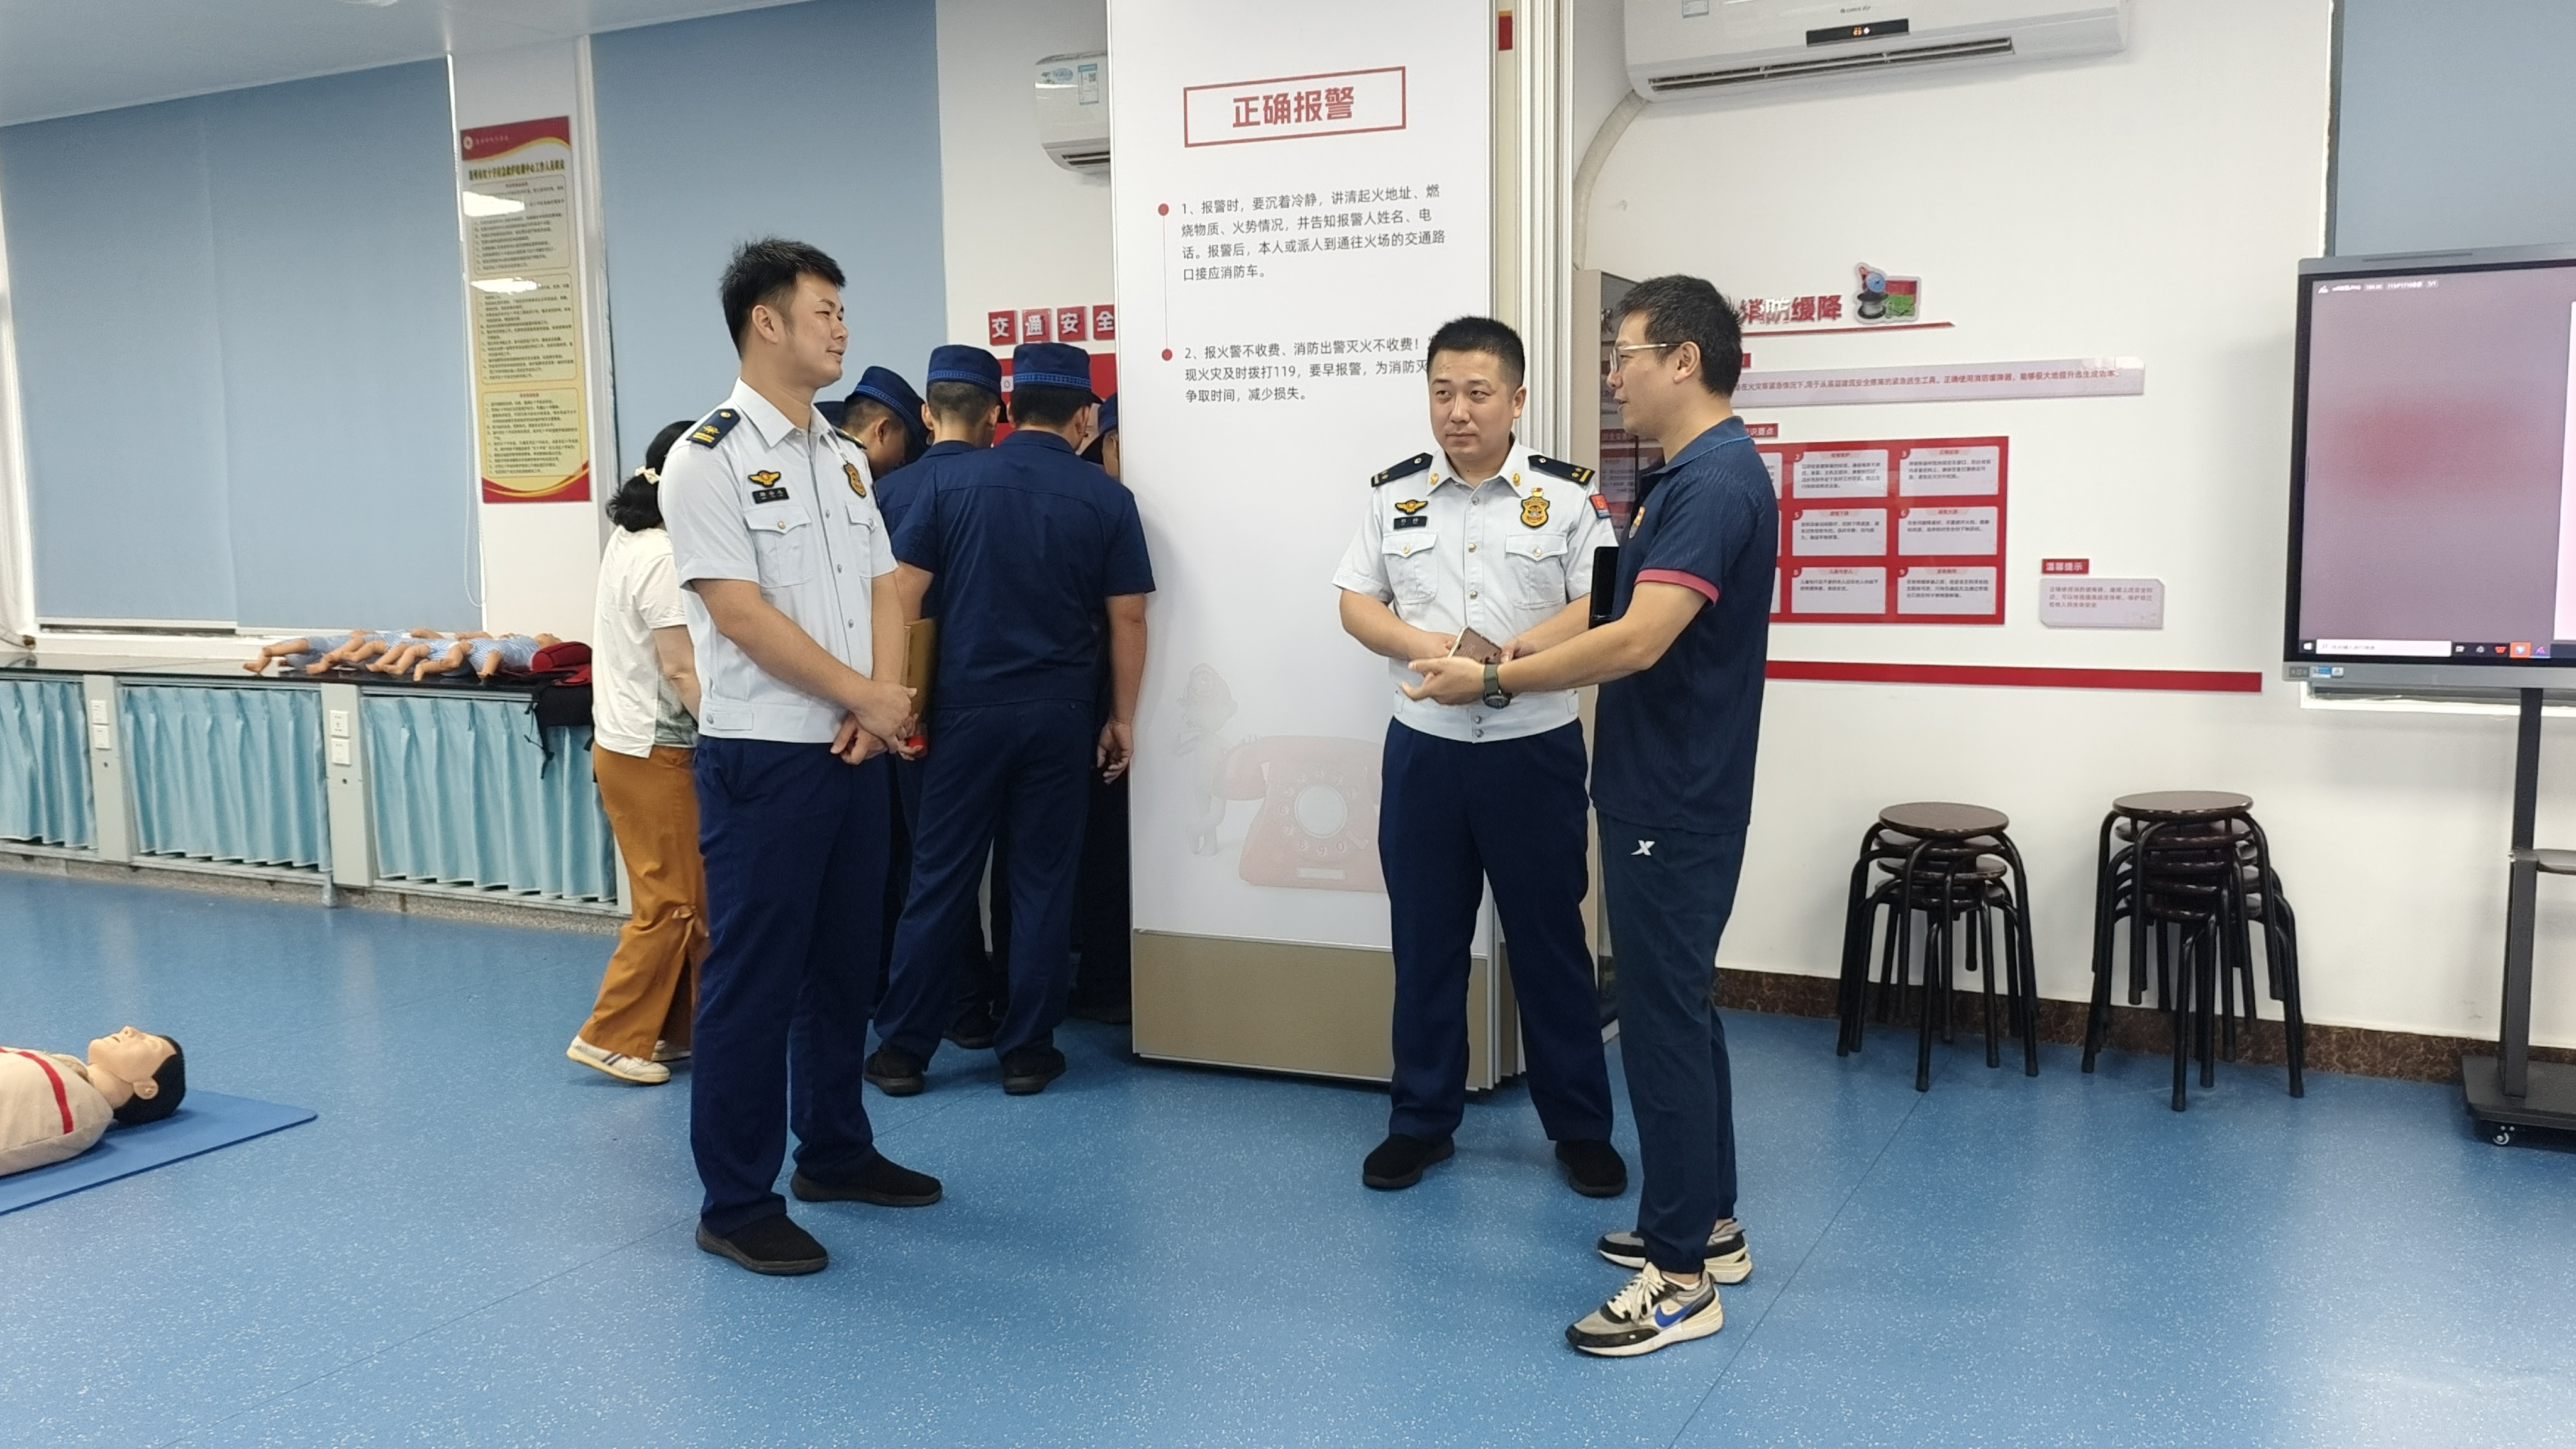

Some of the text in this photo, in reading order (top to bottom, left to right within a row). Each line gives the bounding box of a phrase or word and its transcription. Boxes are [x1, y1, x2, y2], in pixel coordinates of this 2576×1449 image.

[1233, 87, 1354, 128] 正确报警
[1182, 184, 1440, 215] 1、报警时，要沉着冷静，讲清起火地址、燃
[1181, 208, 1432, 238] 烧物质、火势情况，并告知报警人姓名、电
[1182, 229, 1445, 260] 话。报警后，本人或派人到通往火场的交通路
[1184, 264, 1265, 282] 口接应消防车。
[992, 311, 1114, 338] 交通安全
[1184, 334, 1435, 360] 2、报火警不收费、消防出警灭火不收费！
[1185, 386, 1306, 403] 争取时间，减少损失。
[2046, 562, 2084, 572] 温馨提示
